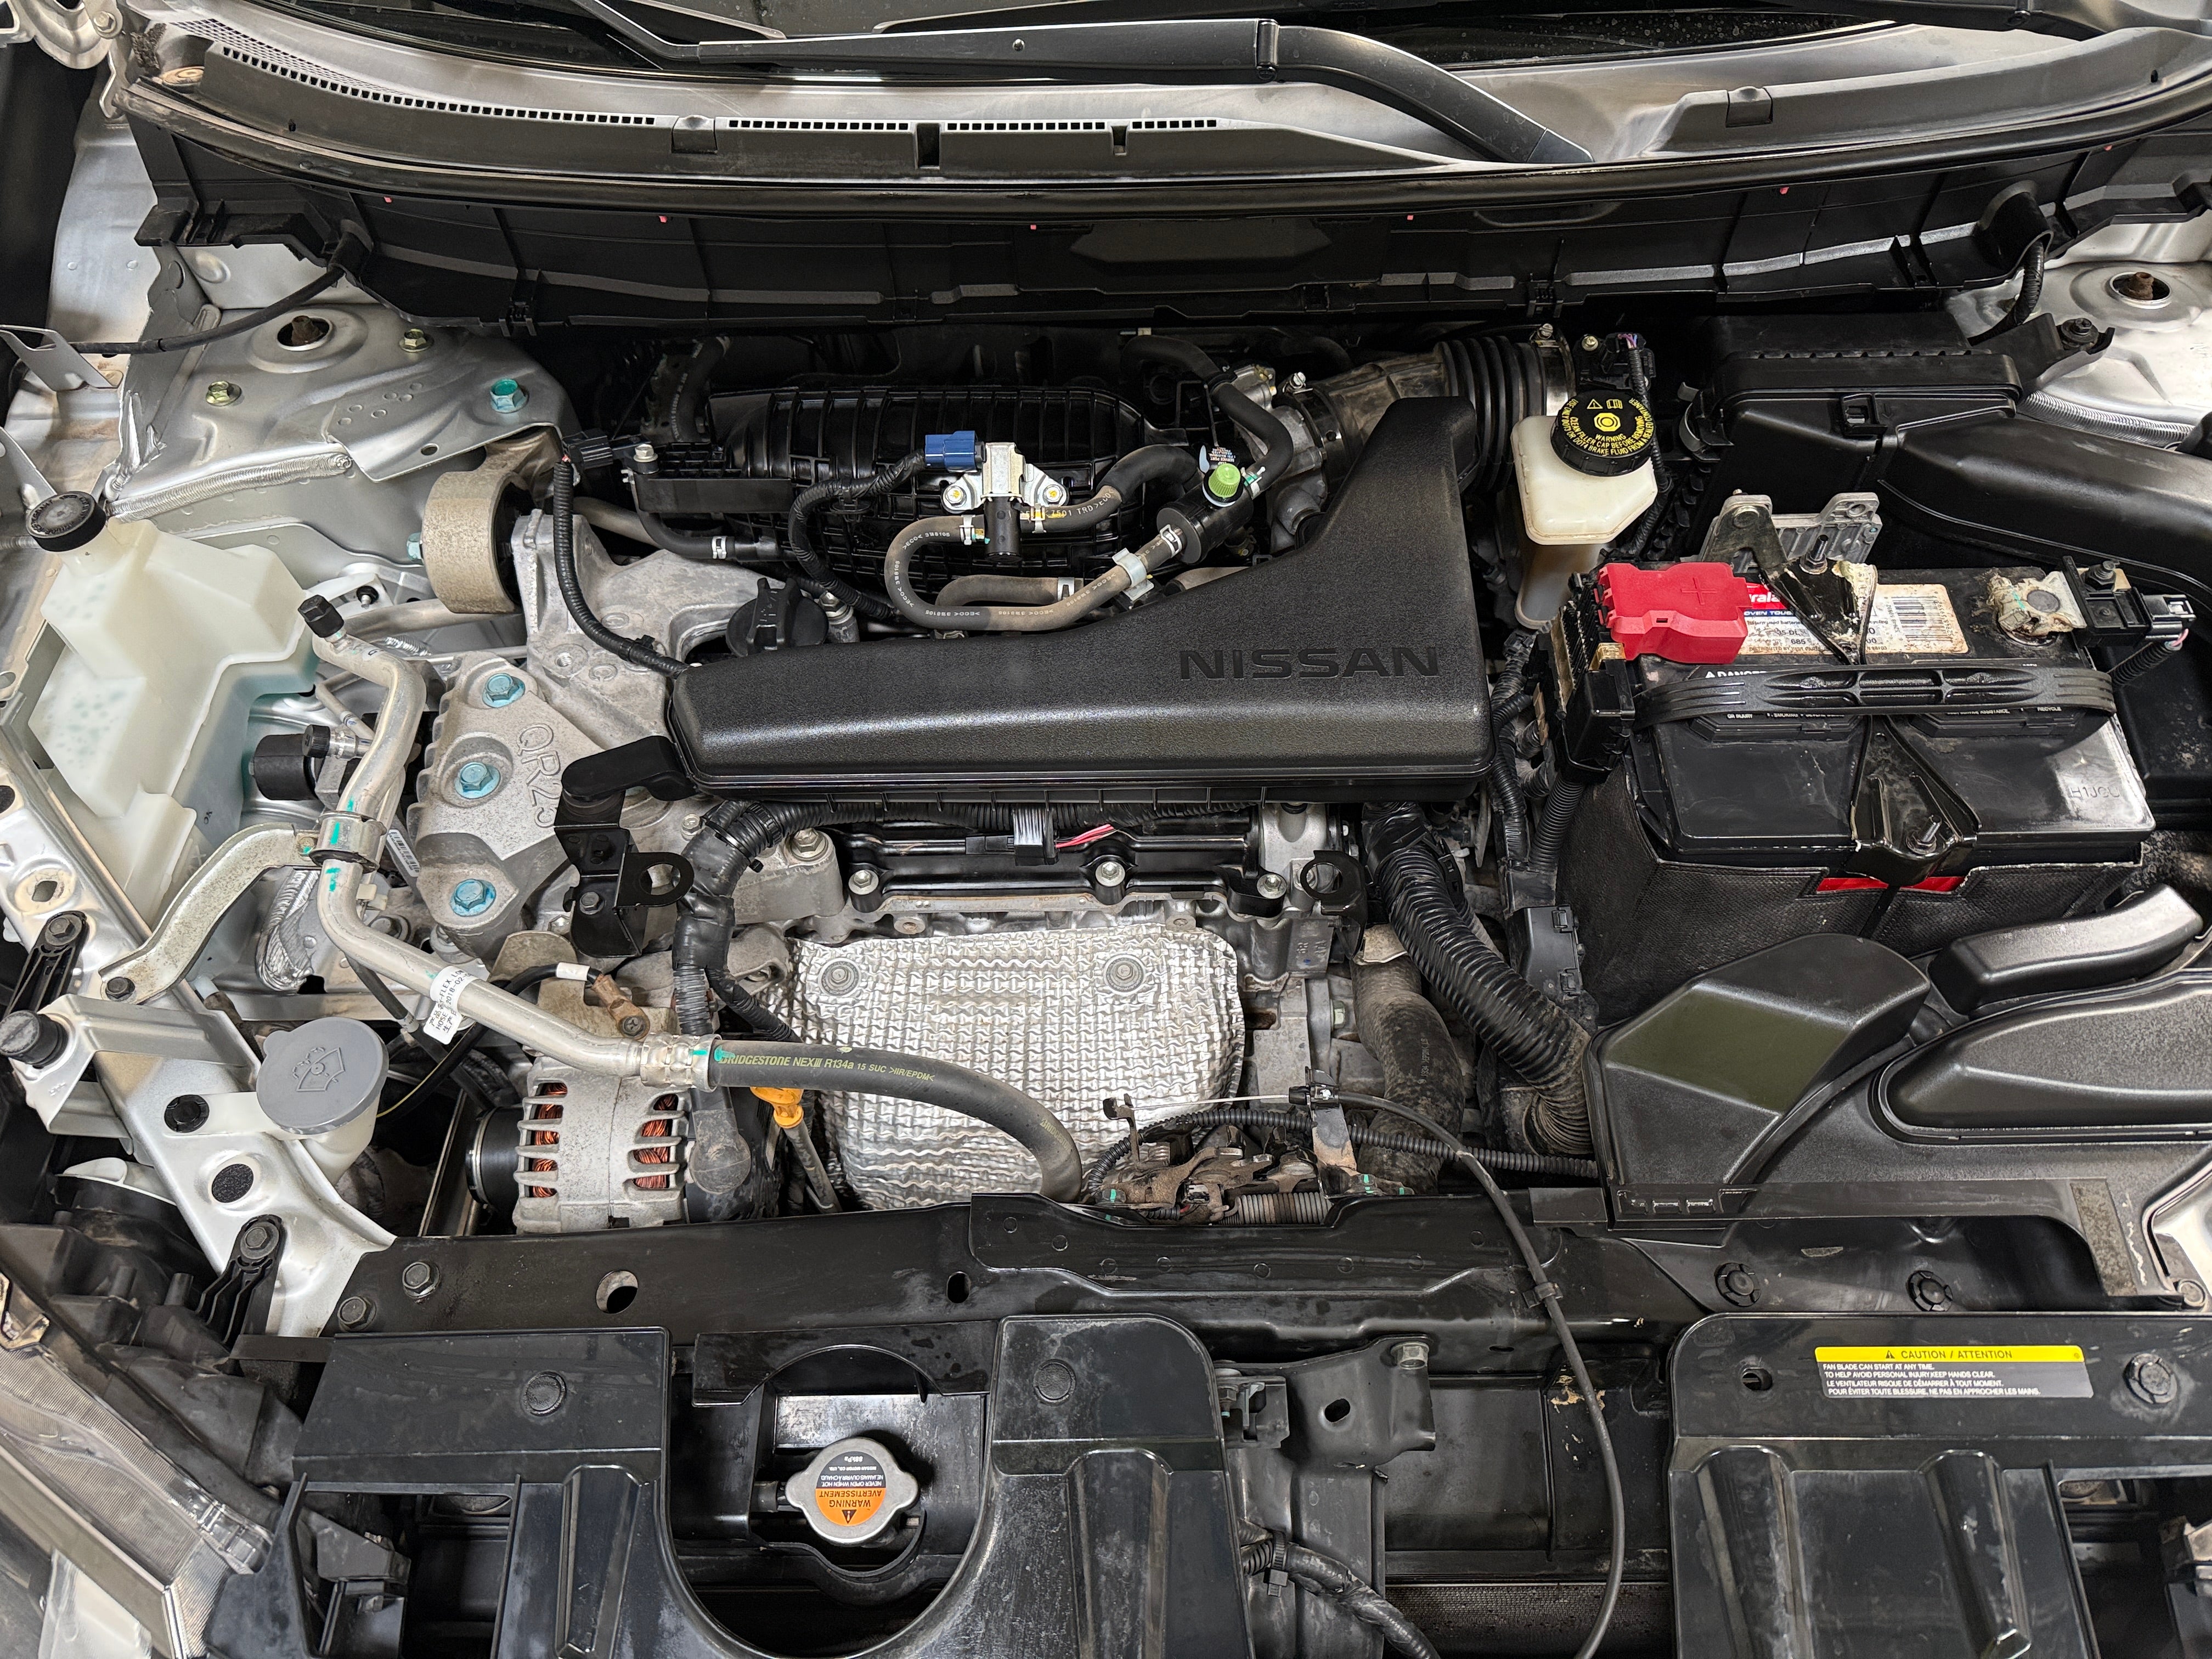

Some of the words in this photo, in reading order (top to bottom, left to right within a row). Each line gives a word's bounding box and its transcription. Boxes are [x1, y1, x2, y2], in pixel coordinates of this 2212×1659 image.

[1566, 399, 1578, 409] USE
[1562, 407, 1572, 419] ONLY
[1629, 398, 1652, 421] CONTAINER
[1566, 431, 1576, 439] OR
[1570, 417, 1581, 433] CLEAN
[1577, 431, 1596, 445] FILLER
[1611, 437, 1635, 448] BEFORE
[1632, 415, 1645, 439] REMOVING
[1643, 422, 1654, 439] SEALED
[1595, 433, 1626, 442] WARNING
[1573, 438, 1589, 449] DOT4
[1628, 441, 1645, 452] FROM
[1588, 445, 1609, 455] BRAKE
[1180, 647, 1440, 680] NISSAN
[436, 1013, 448, 1030] HOSE
[824, 1058, 854, 1069] R134a
[868, 1064, 887, 1073] SUC
[1901, 1350, 1946, 1359] CAUTION
[1950, 1350, 1954, 1359] /
[1958, 1350, 2012, 1359] ATTENTION
[1913, 1379, 1949, 1387] DÉMARRER
[1950, 1379, 1955, 1387] À
[1848, 1386, 1870, 1395] ÉVITER
[819, 1489, 882, 1498] AVERTISSEMENT
[829, 1499, 871, 1508] WARNING
